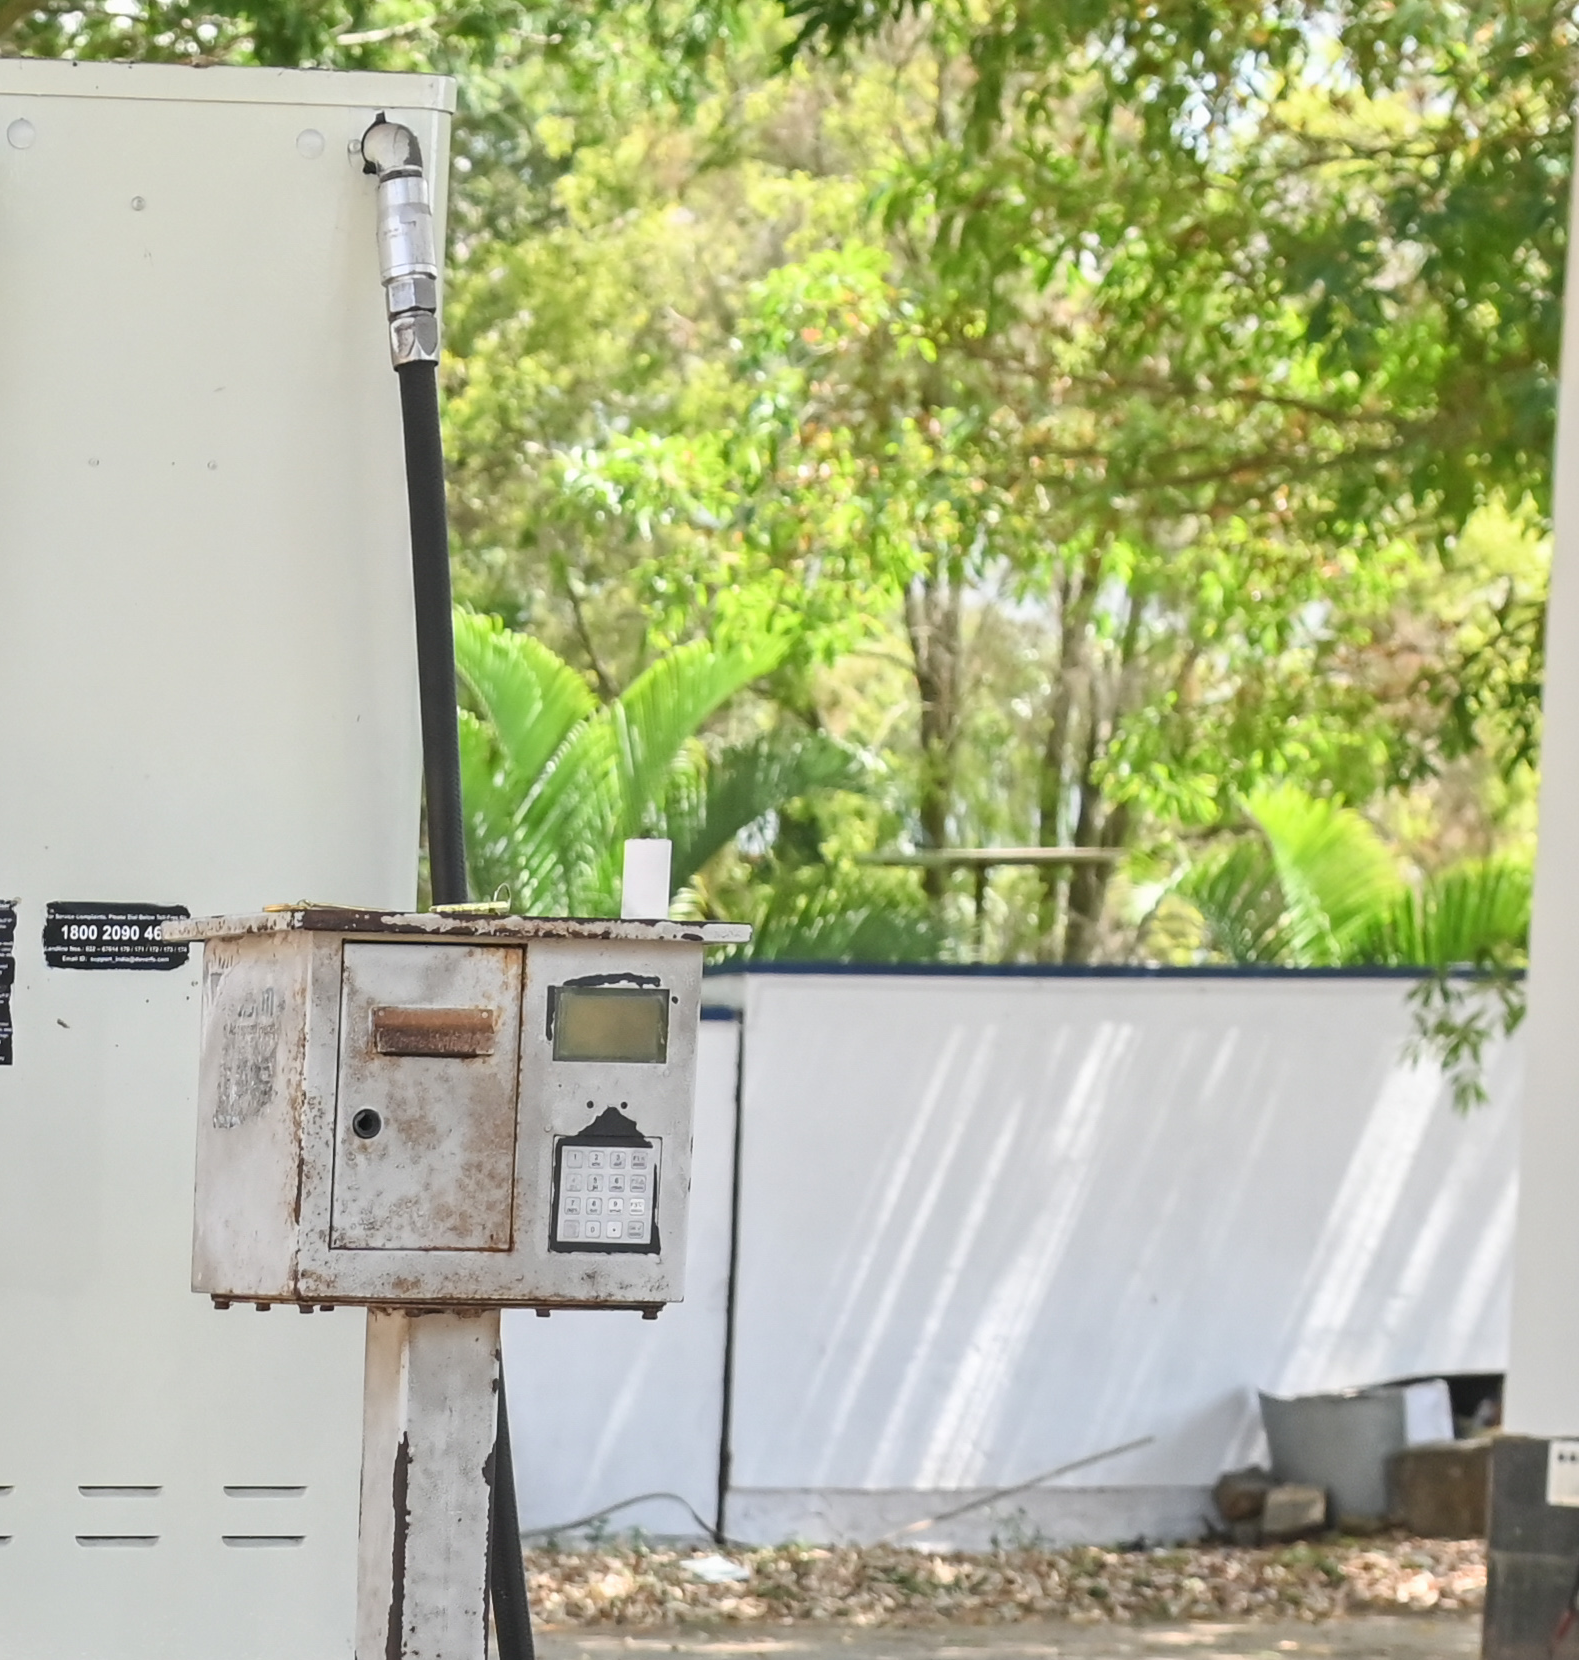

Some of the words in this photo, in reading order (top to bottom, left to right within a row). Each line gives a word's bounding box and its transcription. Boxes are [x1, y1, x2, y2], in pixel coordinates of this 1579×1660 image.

[61, 925, 97, 940] 1800
[103, 925, 139, 940] 2090
[144, 925, 161, 940] 46
